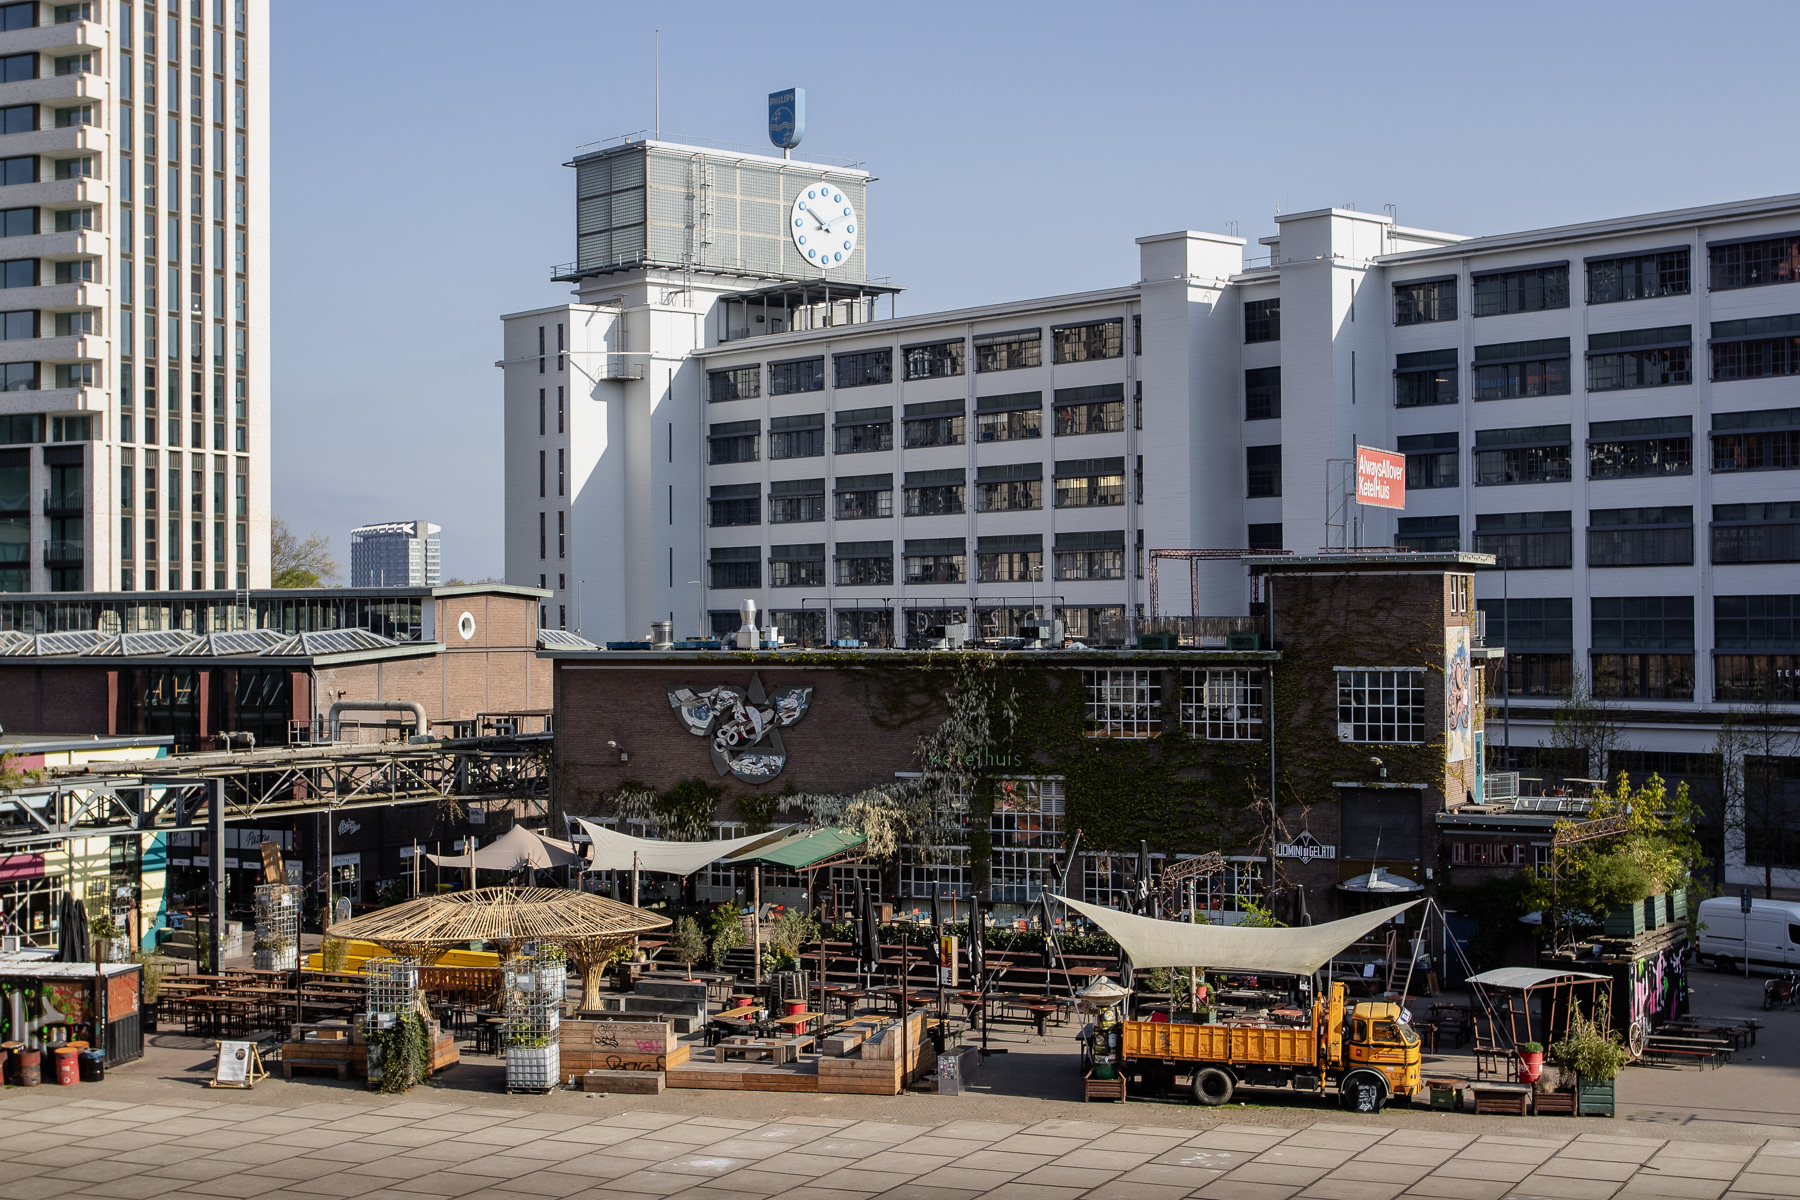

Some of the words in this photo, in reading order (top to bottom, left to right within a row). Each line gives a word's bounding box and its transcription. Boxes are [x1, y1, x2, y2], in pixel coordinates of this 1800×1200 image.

[769, 92, 795, 107] PHILIPS
[1476, 376, 1515, 389] double
[1358, 454, 1403, 481] AlwaysAllover
[1358, 476, 1390, 500] KetelHuis
[1277, 844, 1303, 857] UOMINI
[1309, 845, 1335, 858] GELATO
